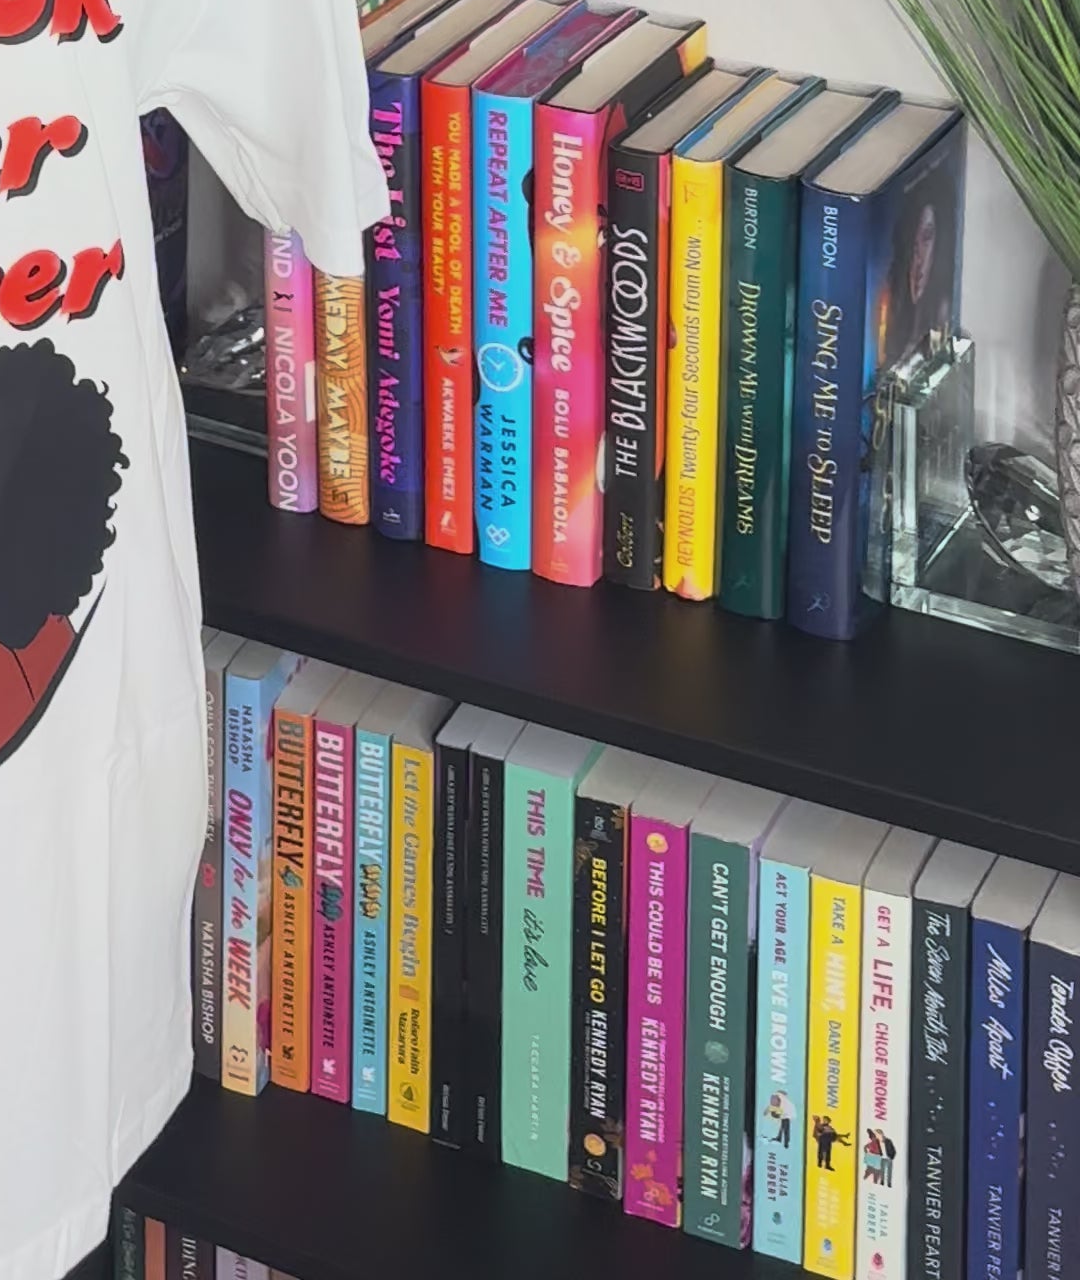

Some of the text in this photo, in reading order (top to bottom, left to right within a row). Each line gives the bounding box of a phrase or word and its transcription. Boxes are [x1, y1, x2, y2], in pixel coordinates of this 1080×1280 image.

[432, 145, 445, 295] WITH YOUR BEAUTY
[449, 111, 462, 335] YOU MADE A FOOL OF DEATH
[487, 109, 510, 327] REPEAT AFTER ME
[544, 131, 583, 373] Honey & Spice
[743, 187, 758, 249] BURTON
[821, 204, 838, 269] BURTON
[686, 274, 702, 311] from
[737, 280, 761, 366] DROWN
[811, 299, 843, 369] SING
[375, 284, 400, 485] Yomi Adegoke
[610, 225, 648, 477] THE BLACKWOODS
[686, 316, 702, 383] Seconds
[739, 367, 759, 400] ME
[275, 326, 299, 512] NICOLA YOON
[327, 379, 350, 479] MAYBE
[441, 377, 456, 501] AKWAEKE EMEZI
[682, 386, 703, 479] Twenty-four
[814, 375, 839, 420] ME
[479, 403, 495, 511] WARMAN
[500, 413, 517, 508] JESSICA
[552, 387, 570, 544] BOLU BABALOLA
[735, 443, 759, 536] DREAMS
[807, 453, 837, 544] SLEEP
[677, 485, 696, 566] REYNOLDS
[228, 708, 240, 766] BISHOP
[241, 703, 253, 773] NATASHA
[275, 720, 304, 868] BUTTERFLY
[315, 730, 344, 888] BUTTERFLY
[359, 741, 383, 864] BUTTERFLY
[526, 788, 546, 837] THIS
[228, 789, 254, 1010] ONLY for the WEEK
[400, 757, 421, 978] Let the Games Begin
[527, 847, 545, 898] TIME
[590, 857, 607, 924] BEFORE
[648, 860, 664, 897] THIS
[775, 871, 787, 900] ACT
[281, 891, 295, 1036] ASHLEY ANTOINETTE
[590, 942, 606, 975] LET
[647, 900, 663, 954] COULD
[709, 862, 728, 1031] CAN'T GET ENOUGH
[774, 902, 787, 935] YOUR
[831, 895, 846, 946] TAKE A
[926, 910, 950, 937] The
[926, 938, 949, 983] Seven
[201, 921, 215, 1045] NATASHA BISHOP
[320, 924, 336, 1049] ASHLEY ANTOINETTE
[363, 930, 377, 1056] ASHLEY ANTOINETTE
[522, 945, 548, 993] love
[589, 978, 605, 1004] GO
[646, 982, 663, 1005] US
[647, 956, 662, 980] BE
[869, 904, 894, 1121] GET A LIFE, CHLOE BROWN
[981, 942, 1013, 1080] Miles Apart
[589, 1009, 608, 1119] KENNEDY RYAN
[769, 969, 788, 1084] EVE BROWN
[826, 1019, 841, 1109] DANI BROWN
[1043, 975, 1074, 1093] Tender Offer
[640, 1017, 659, 1142] KENNEDY RYAN
[700, 1072, 720, 1198] KENNEDY RYAN
[767, 1151, 778, 1202] HIBBERT
[778, 1163, 789, 1197] TALIA
[879, 1203, 889, 1238] TALIA
[924, 1145, 942, 1280] TANVIER PEART
[987, 1184, 1002, 1250] TANVIER
[1047, 1207, 1062, 1271] TANVIER
